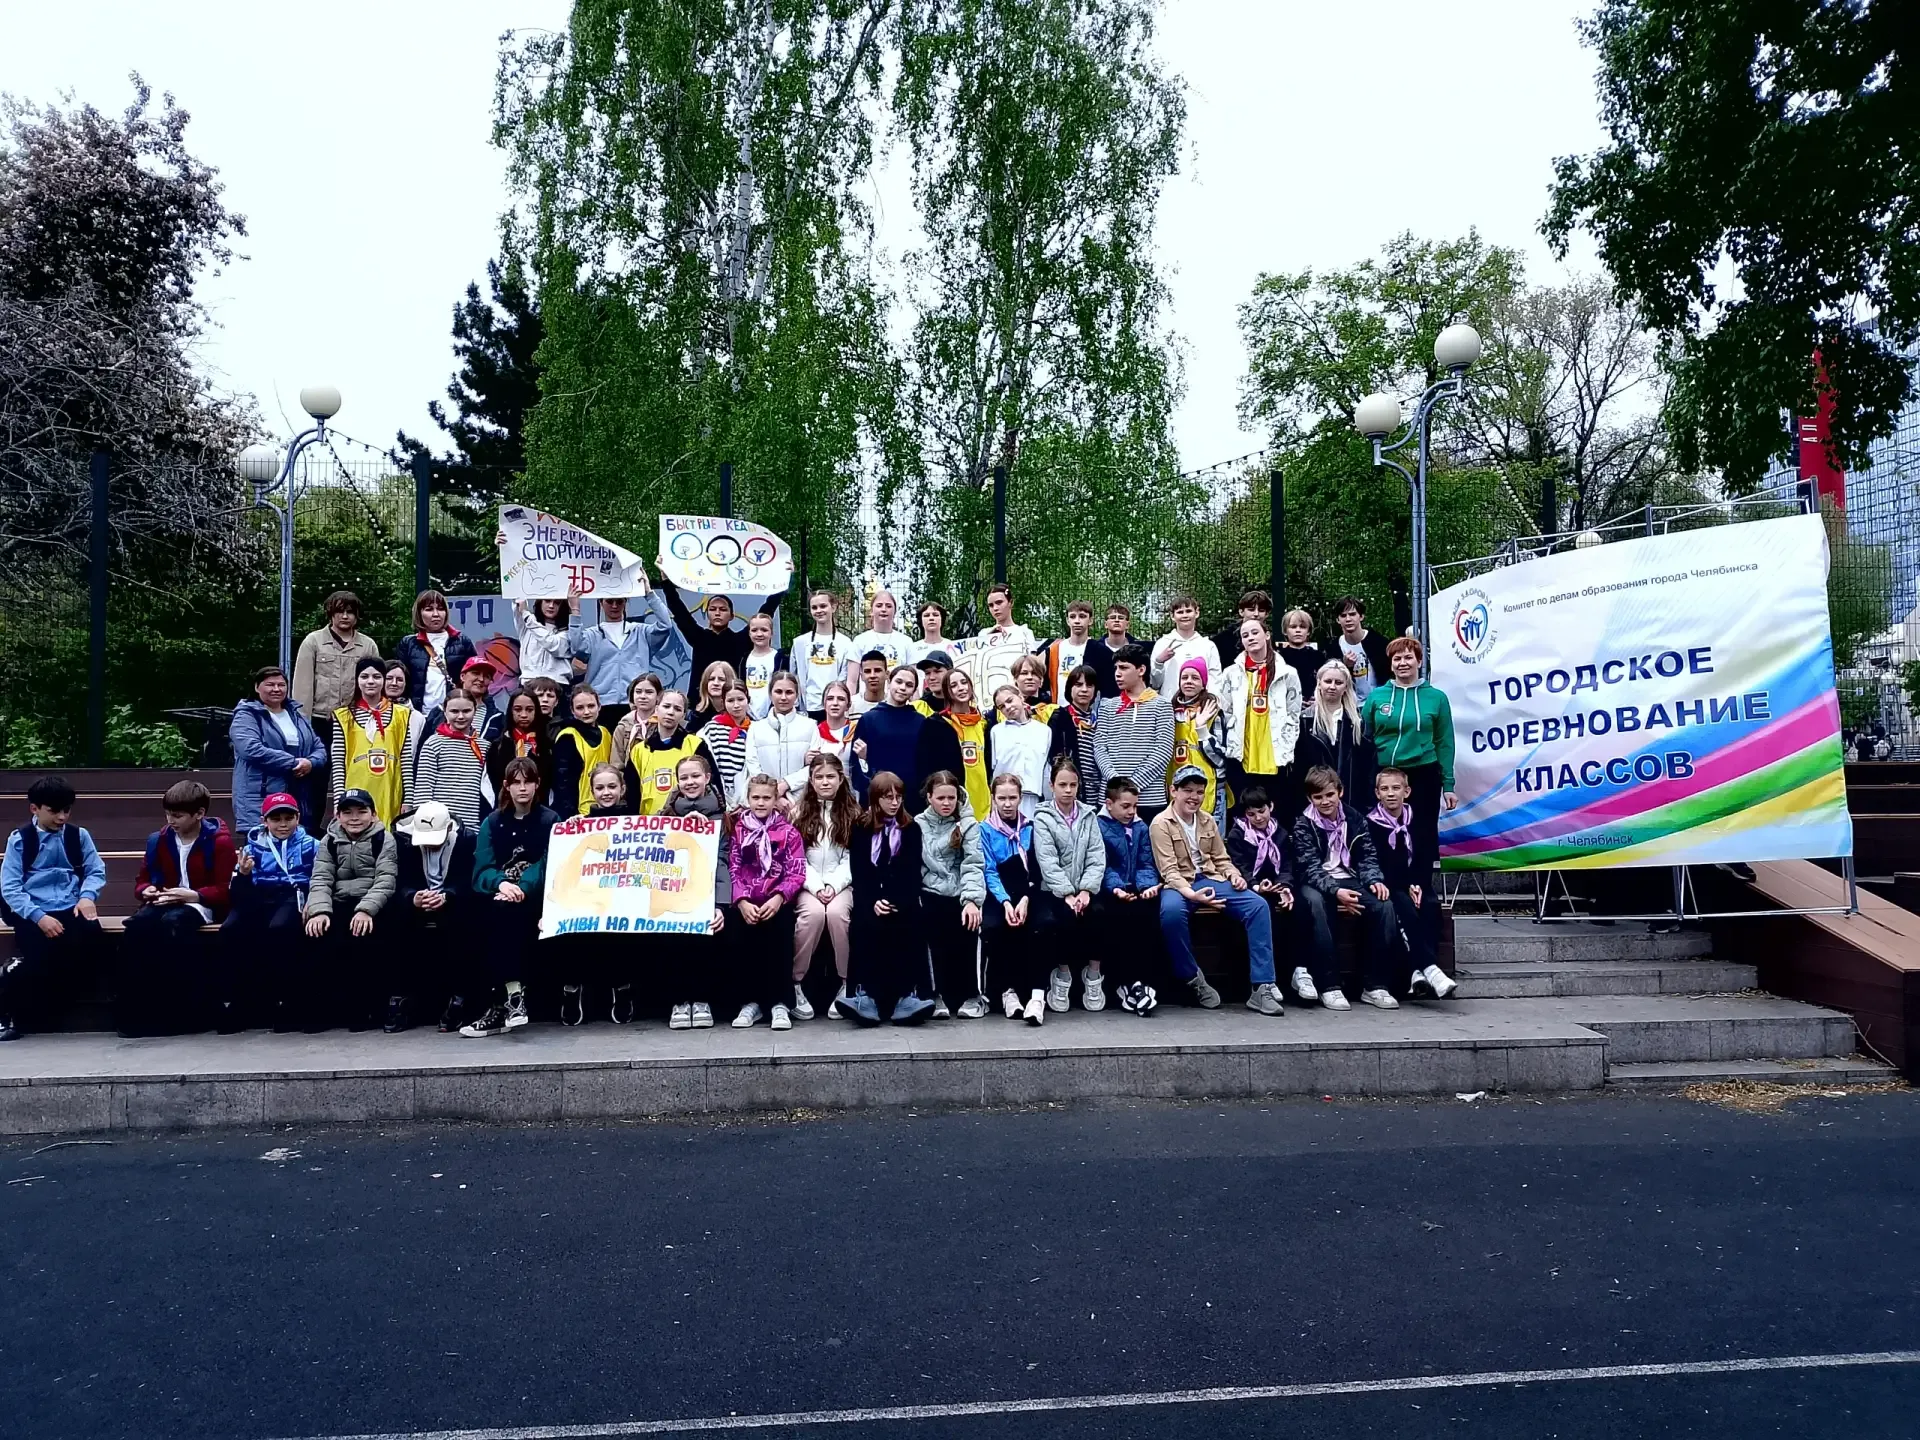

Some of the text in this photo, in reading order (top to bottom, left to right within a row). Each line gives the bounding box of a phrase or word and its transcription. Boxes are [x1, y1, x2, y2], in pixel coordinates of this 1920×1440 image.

[666, 518, 717, 531] БЫСТРЫЕ
[1503, 563, 1758, 613] Комитет по делам образования города Челябинска
[448, 599, 494, 624] ТО
[1488, 646, 1715, 705] ГОРОДСКОЕ
[1471, 692, 1772, 753] СОРЕВНОВАНИЕ
[1515, 752, 1695, 793] КЛАССОВ
[612, 832, 666, 845] ВМЕСТЕ
[1567, 834, 1633, 847] Челябинск
[581, 861, 683, 877] ИГРАЕМ БЕГАЕМ
[555, 916, 599, 934] ЖИВИ
[605, 915, 630, 931] НА
